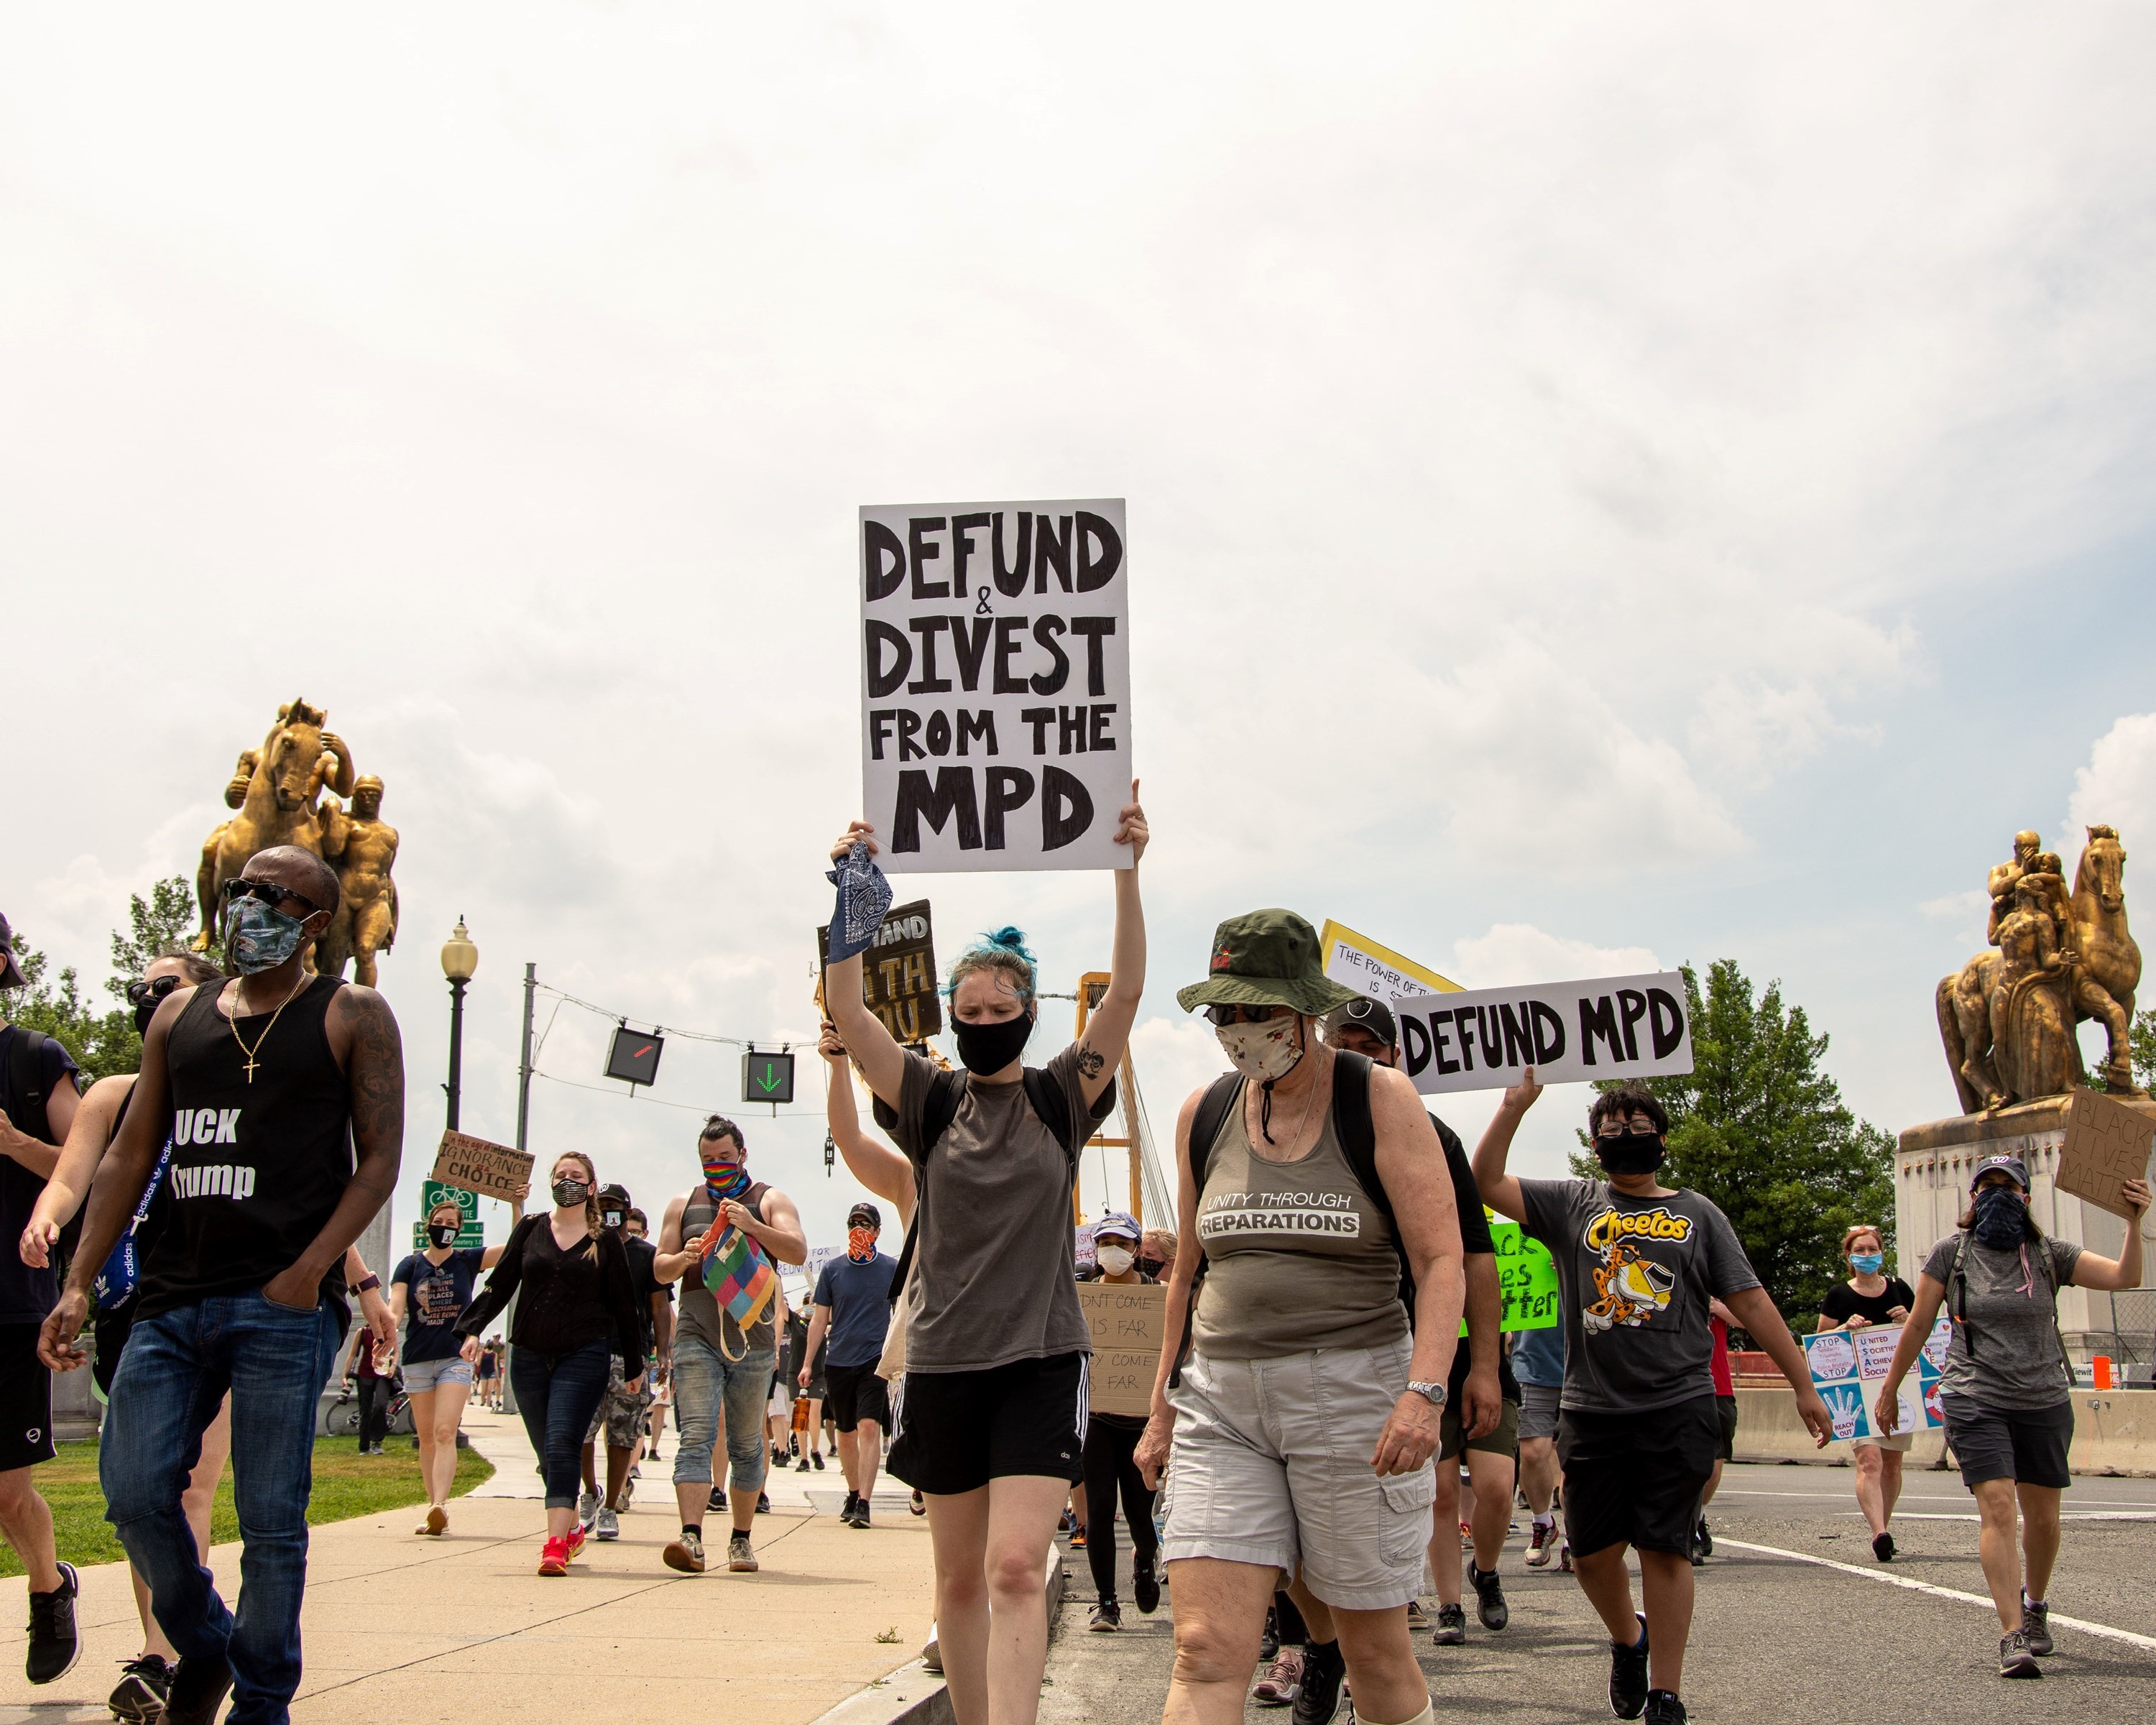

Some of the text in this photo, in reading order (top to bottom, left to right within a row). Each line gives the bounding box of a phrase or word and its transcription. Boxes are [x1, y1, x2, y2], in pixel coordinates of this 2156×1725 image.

[865, 511, 1123, 602] DEFUND
[975, 586, 993, 614] &
[865, 614, 1118, 698] DIVEST
[870, 704, 1118, 762] FROM THE
[891, 765, 1095, 854] MPD
[871, 915, 929, 949] TAND
[1339, 945, 1363, 966] THE
[1365, 958, 1401, 988] POWER
[1403, 980, 1417, 995] OF
[1369, 980, 1380, 993] IS
[871, 998, 919, 1040] OU
[1399, 988, 1685, 1077] DEFUND MPD
[2076, 1097, 2151, 1156] BLACK
[438, 1142, 532, 1177] IGNORANCE
[447, 1133, 534, 1164] In the age of information
[2072, 1128, 2142, 1179] LIVES
[170, 1164, 256, 1200] Trump
[448, 1162, 517, 1192] CHOICE
[2061, 1158, 2129, 1208] MATTE
[137, 1182, 157, 1217] adidas
[1207, 1192, 1352, 1210] UNITY THROUGH
[1202, 1213, 1358, 1236] REPARATIONS
[1587, 1208, 1690, 1249] Cheetos
[124, 1242, 134, 1276] adidas
[812, 1247, 831, 1257] FOR
[430, 1305, 461, 1313] DECISIONS
[1116, 1294, 1157, 1310] COME
[1501, 1287, 1558, 1322] tter
[1118, 1319, 1148, 1338] FAR
[1815, 1337, 1840, 1348] STOP
[1112, 1354, 1156, 1366] COME
[1823, 1368, 1846, 1378] STOP
[1107, 1375, 1139, 1389] FAR
[1834, 1422, 1854, 1431] REACH
